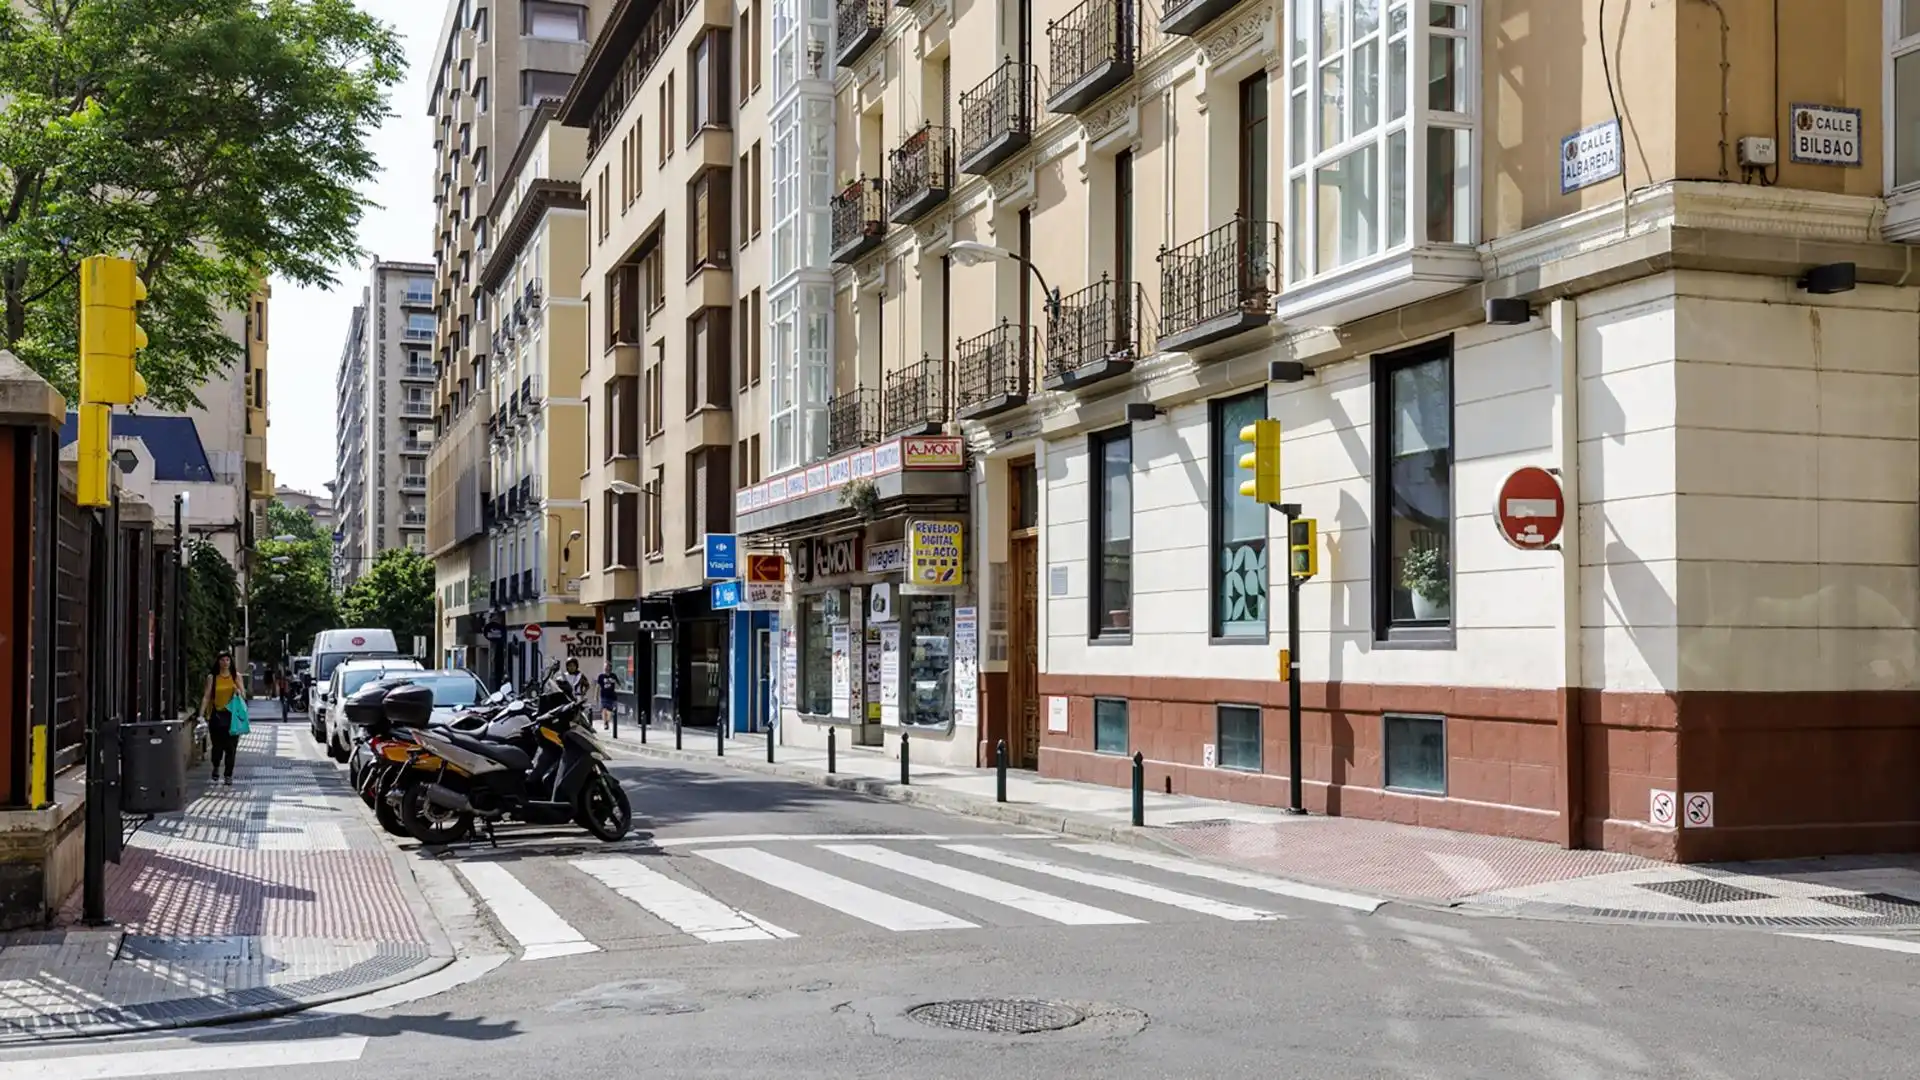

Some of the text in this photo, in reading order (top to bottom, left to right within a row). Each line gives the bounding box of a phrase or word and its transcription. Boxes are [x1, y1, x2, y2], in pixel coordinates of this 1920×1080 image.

[1816, 117, 1852, 132] CALLE
[1580, 131, 1612, 153] CALLE
[1800, 136, 1853, 157] BILBAO
[1565, 149, 1615, 180] ALBAREDA
[915, 522, 960, 534] REVELADO
[921, 535, 953, 545] DIGITAL
[868, 547, 899, 569] Imagen
[932, 547, 958, 557] ACTO
[709, 560, 734, 570] Viajes
[576, 631, 602, 646] San
[566, 643, 604, 658] Remo
